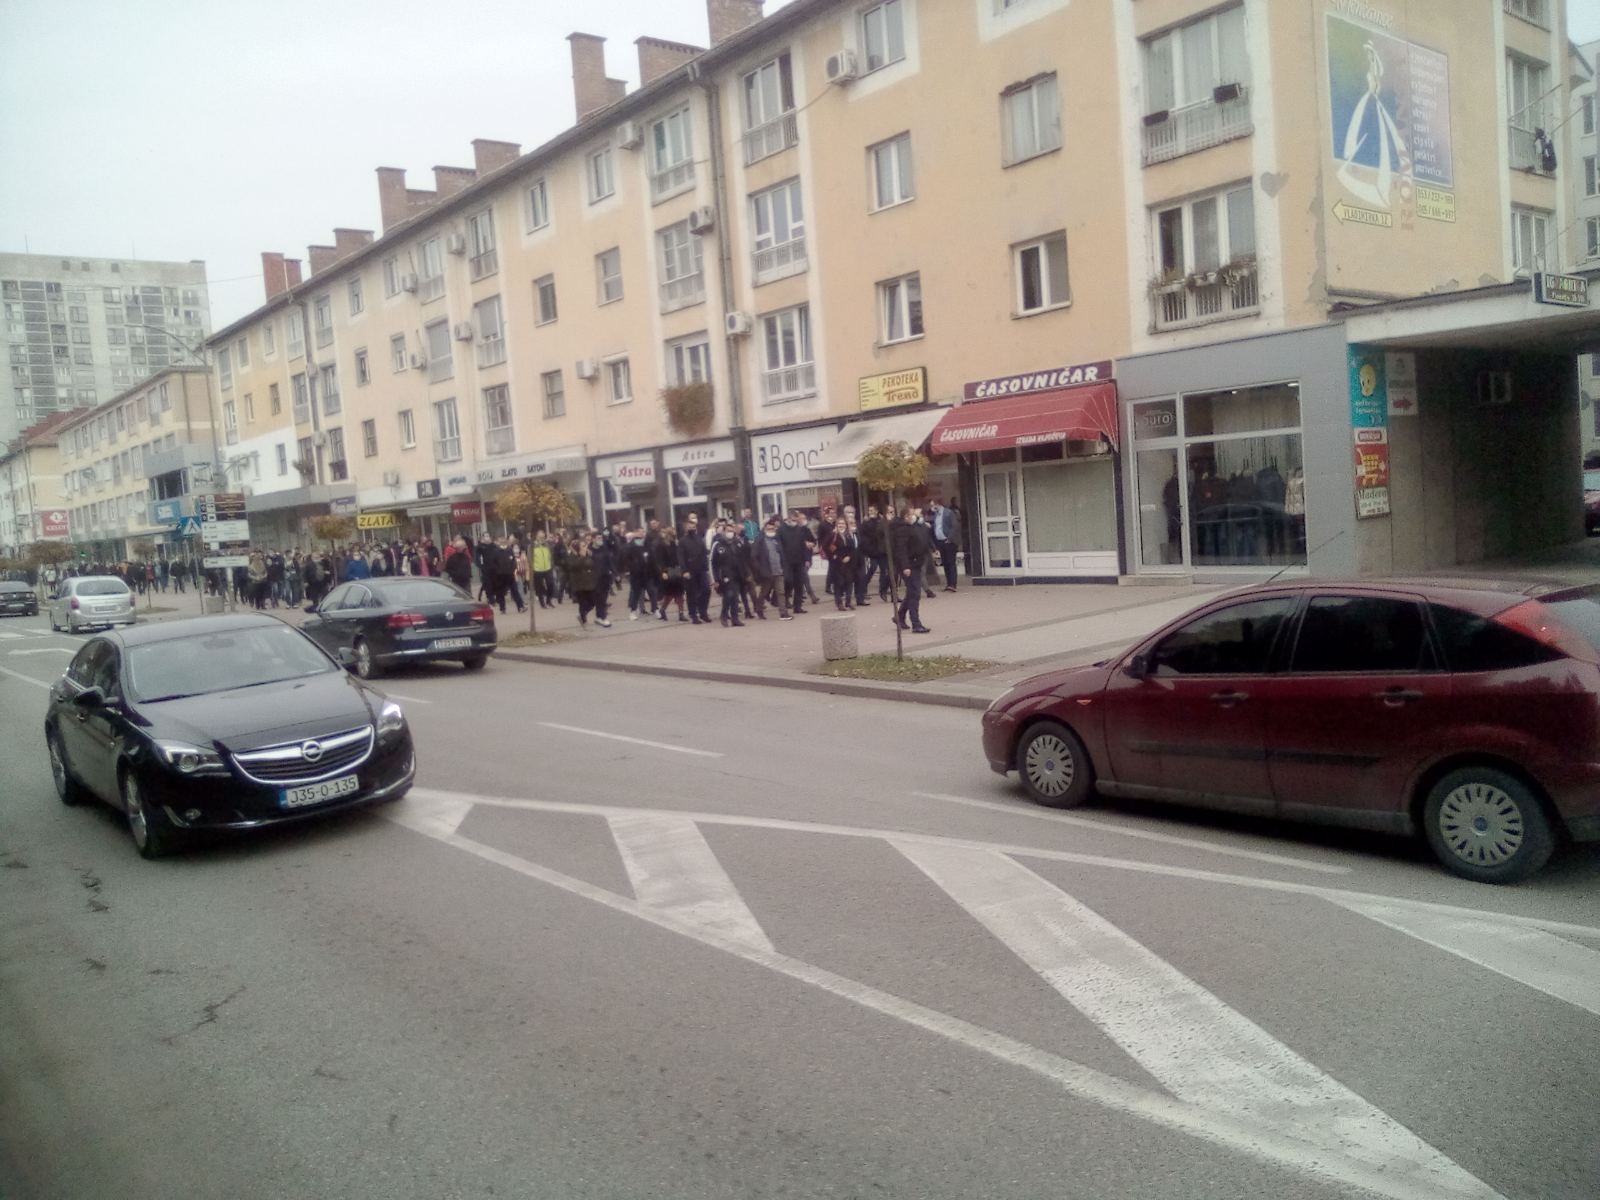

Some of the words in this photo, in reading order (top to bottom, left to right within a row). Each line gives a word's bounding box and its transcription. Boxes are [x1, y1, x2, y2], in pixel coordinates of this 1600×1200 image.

[976, 366, 1099, 397] ČASOVNIČAR
[939, 424, 998, 442] ČASOVNIČAR
[681, 450, 715, 462] Astra
[618, 465, 652, 478] Astra
